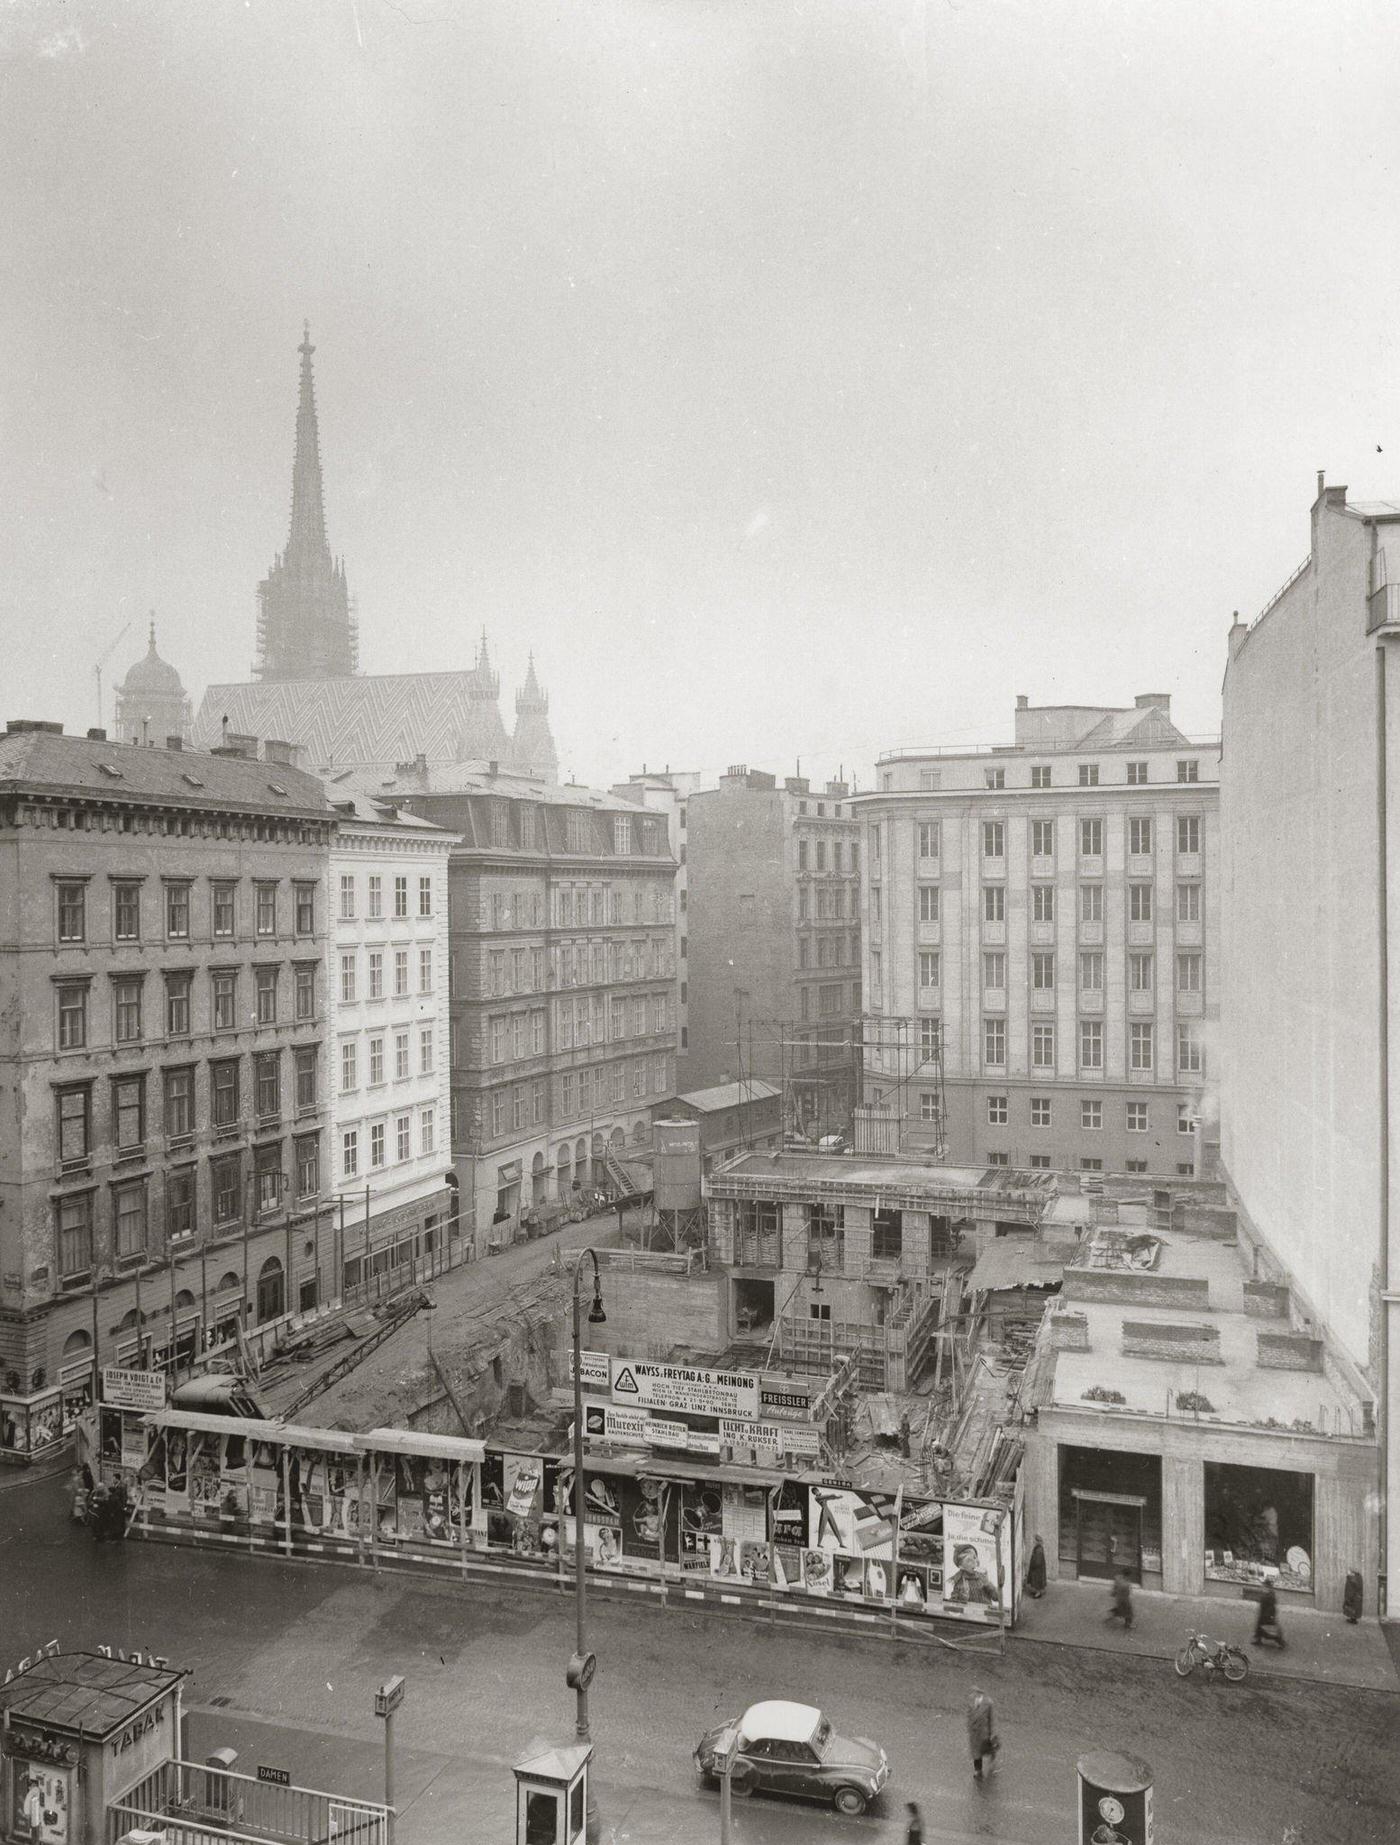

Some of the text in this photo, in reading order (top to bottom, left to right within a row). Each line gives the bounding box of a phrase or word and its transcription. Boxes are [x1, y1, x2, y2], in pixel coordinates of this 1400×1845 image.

[106, 1370, 128, 1380] JOSEPH
[130, 1373, 149, 1382] VOIGT
[580, 1368, 607, 1378] BACON
[635, 1364, 660, 1377] WAYSS
[664, 1368, 696, 1382] FREYTAG
[717, 1374, 754, 1389] MEINONG
[652, 1393, 680, 1401] TELEPHON
[688, 1387, 738, 1398] STAHLBETONBAU
[763, 1393, 806, 1407] FREISSLER
[669, 1401, 688, 1409] GRAZ
[691, 1403, 706, 1412] LINZ
[710, 1406, 753, 1418] INNSBRUCK
[652, 1428, 680, 1438] STAHLBAU
[723, 1421, 745, 1433] LICHT
[749, 1424, 779, 1438] KRAFT
[111, 1702, 164, 1757] TABAK
[260, 1767, 289, 1783] DAMEN
